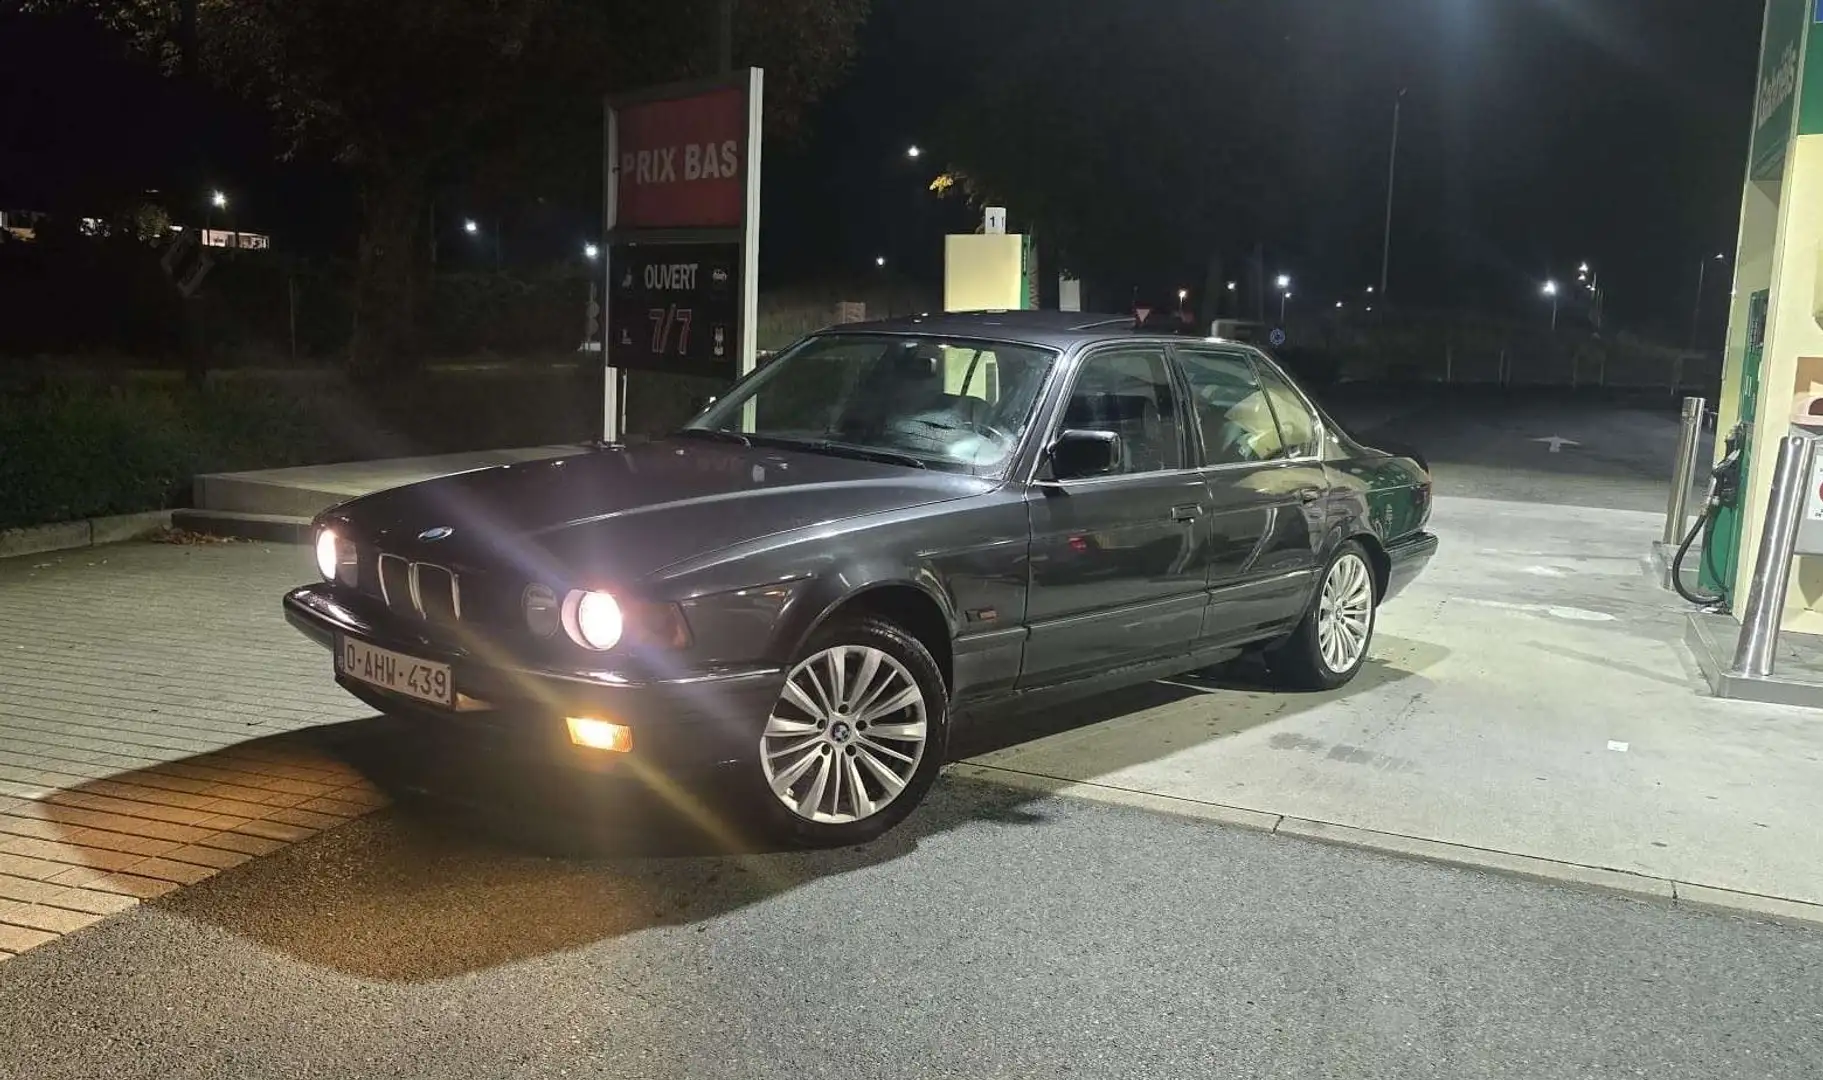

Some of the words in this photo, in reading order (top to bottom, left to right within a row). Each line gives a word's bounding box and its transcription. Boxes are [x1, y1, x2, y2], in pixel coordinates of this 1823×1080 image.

[622, 145, 677, 184] PRIX
[685, 140, 738, 180] BAS
[644, 263, 698, 290] OUVERT
[649, 303, 692, 355] 7/7
